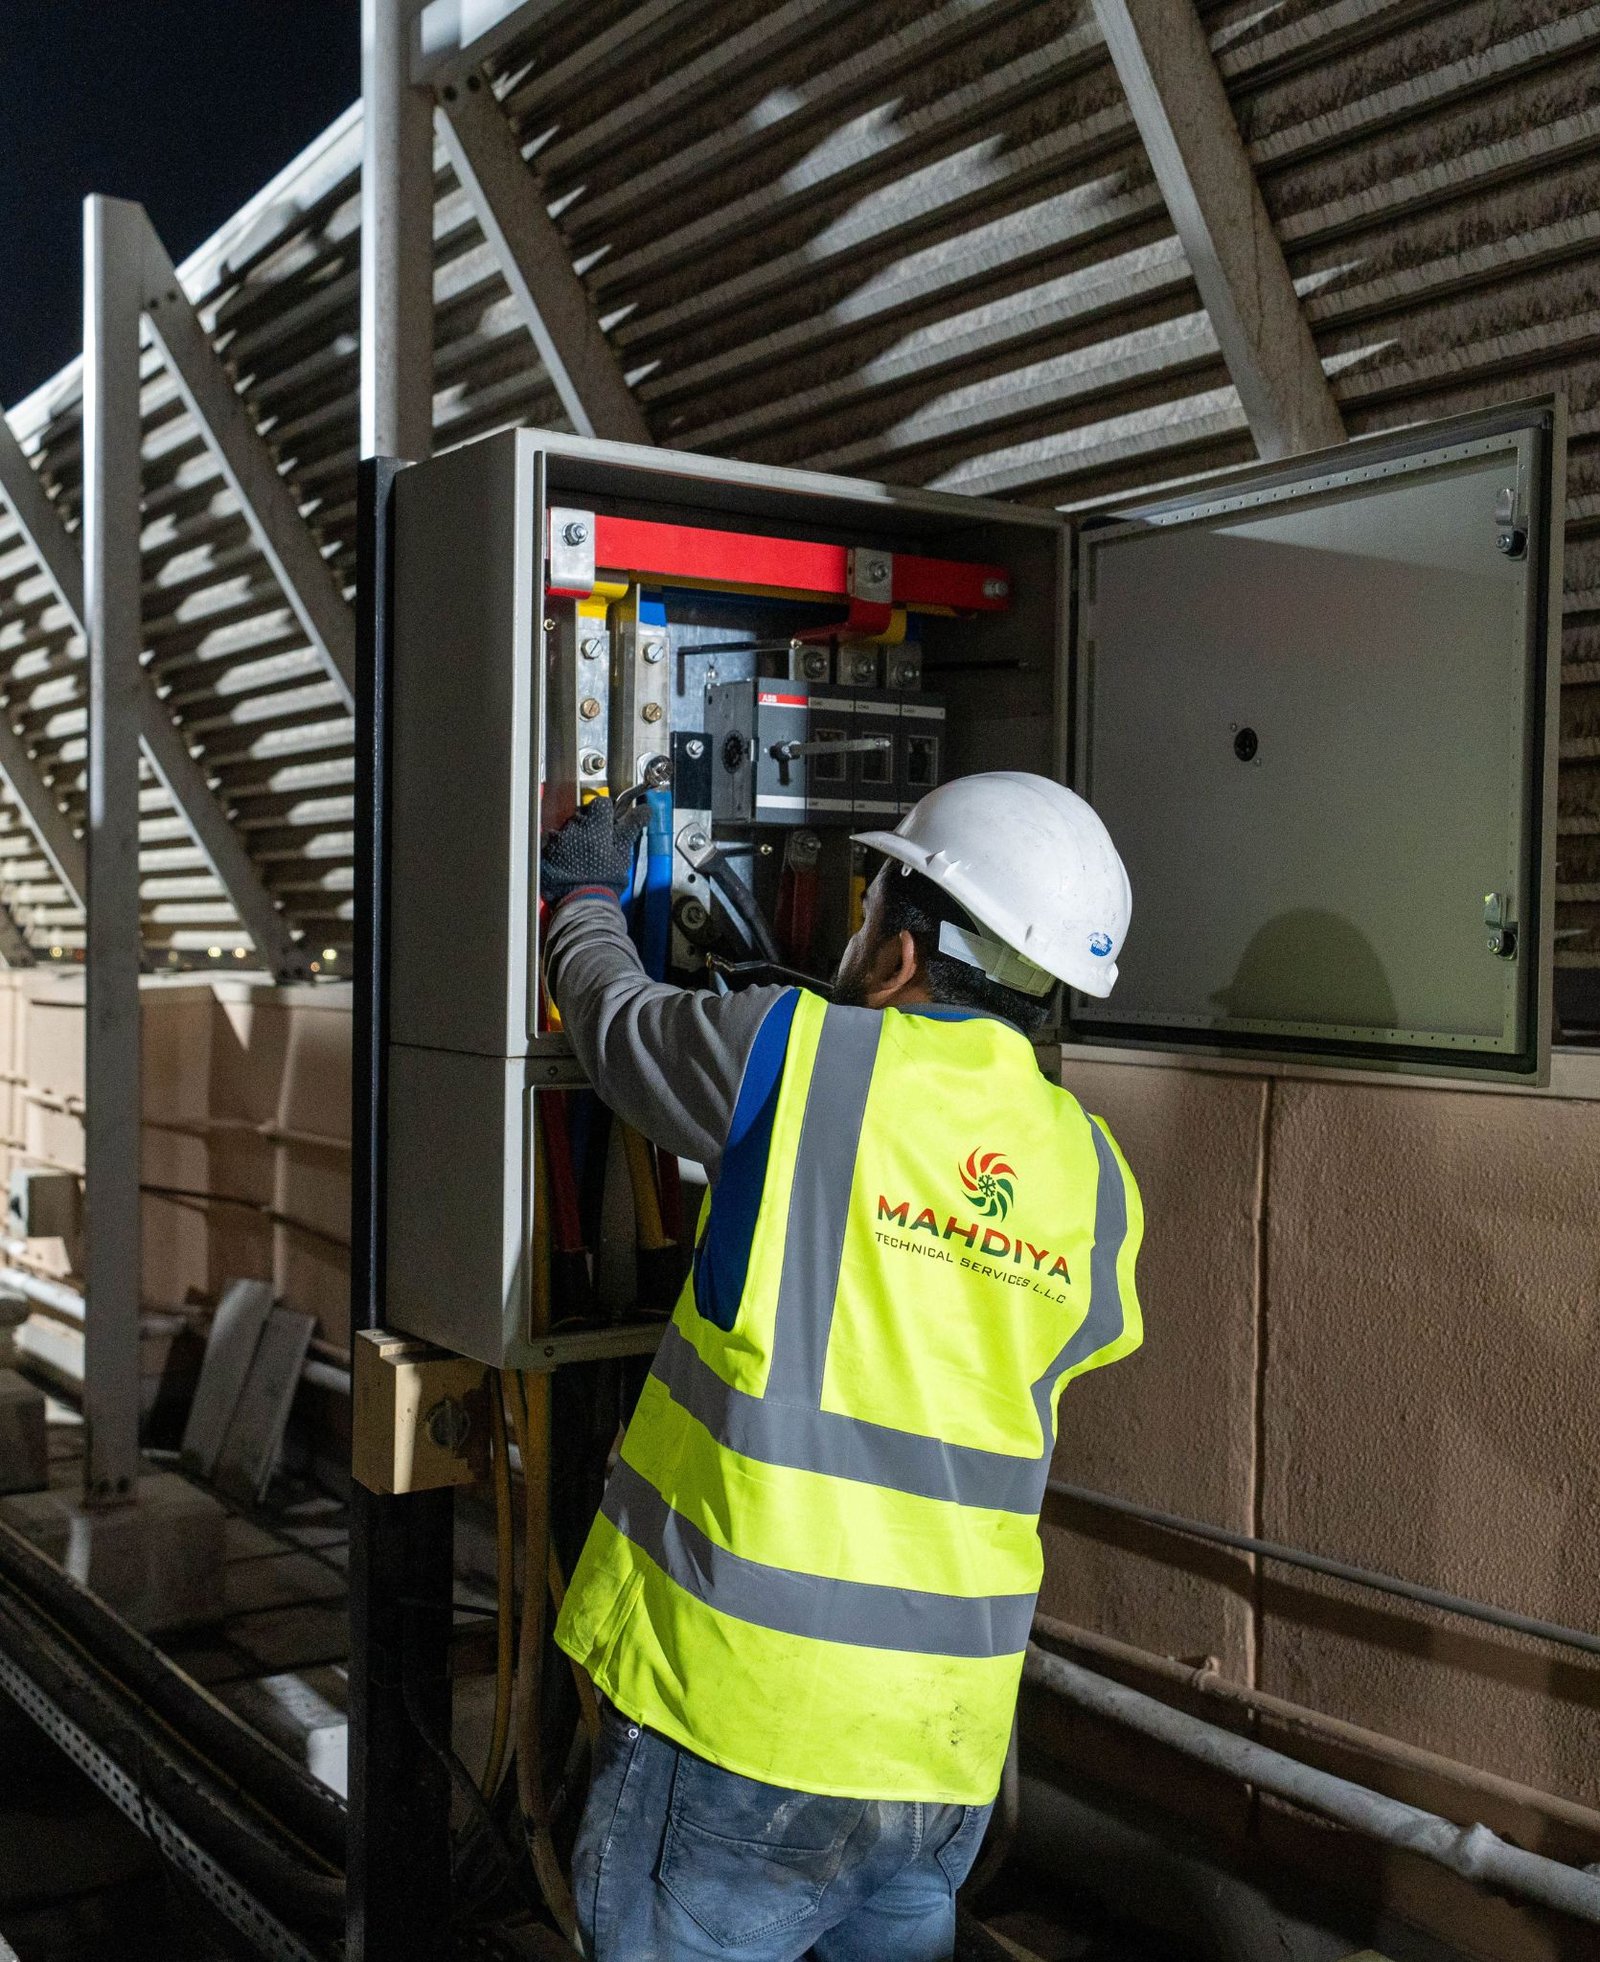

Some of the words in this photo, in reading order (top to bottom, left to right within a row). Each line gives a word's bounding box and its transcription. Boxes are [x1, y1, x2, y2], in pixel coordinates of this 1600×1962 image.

[761, 694, 777, 703] ABB
[875, 1231, 953, 1263] TECHNICAL
[960, 1257, 1031, 1288] SERVICES
[1032, 1283, 1067, 1304] L.L.C
[877, 1194, 1071, 1285] MAHDIYA
